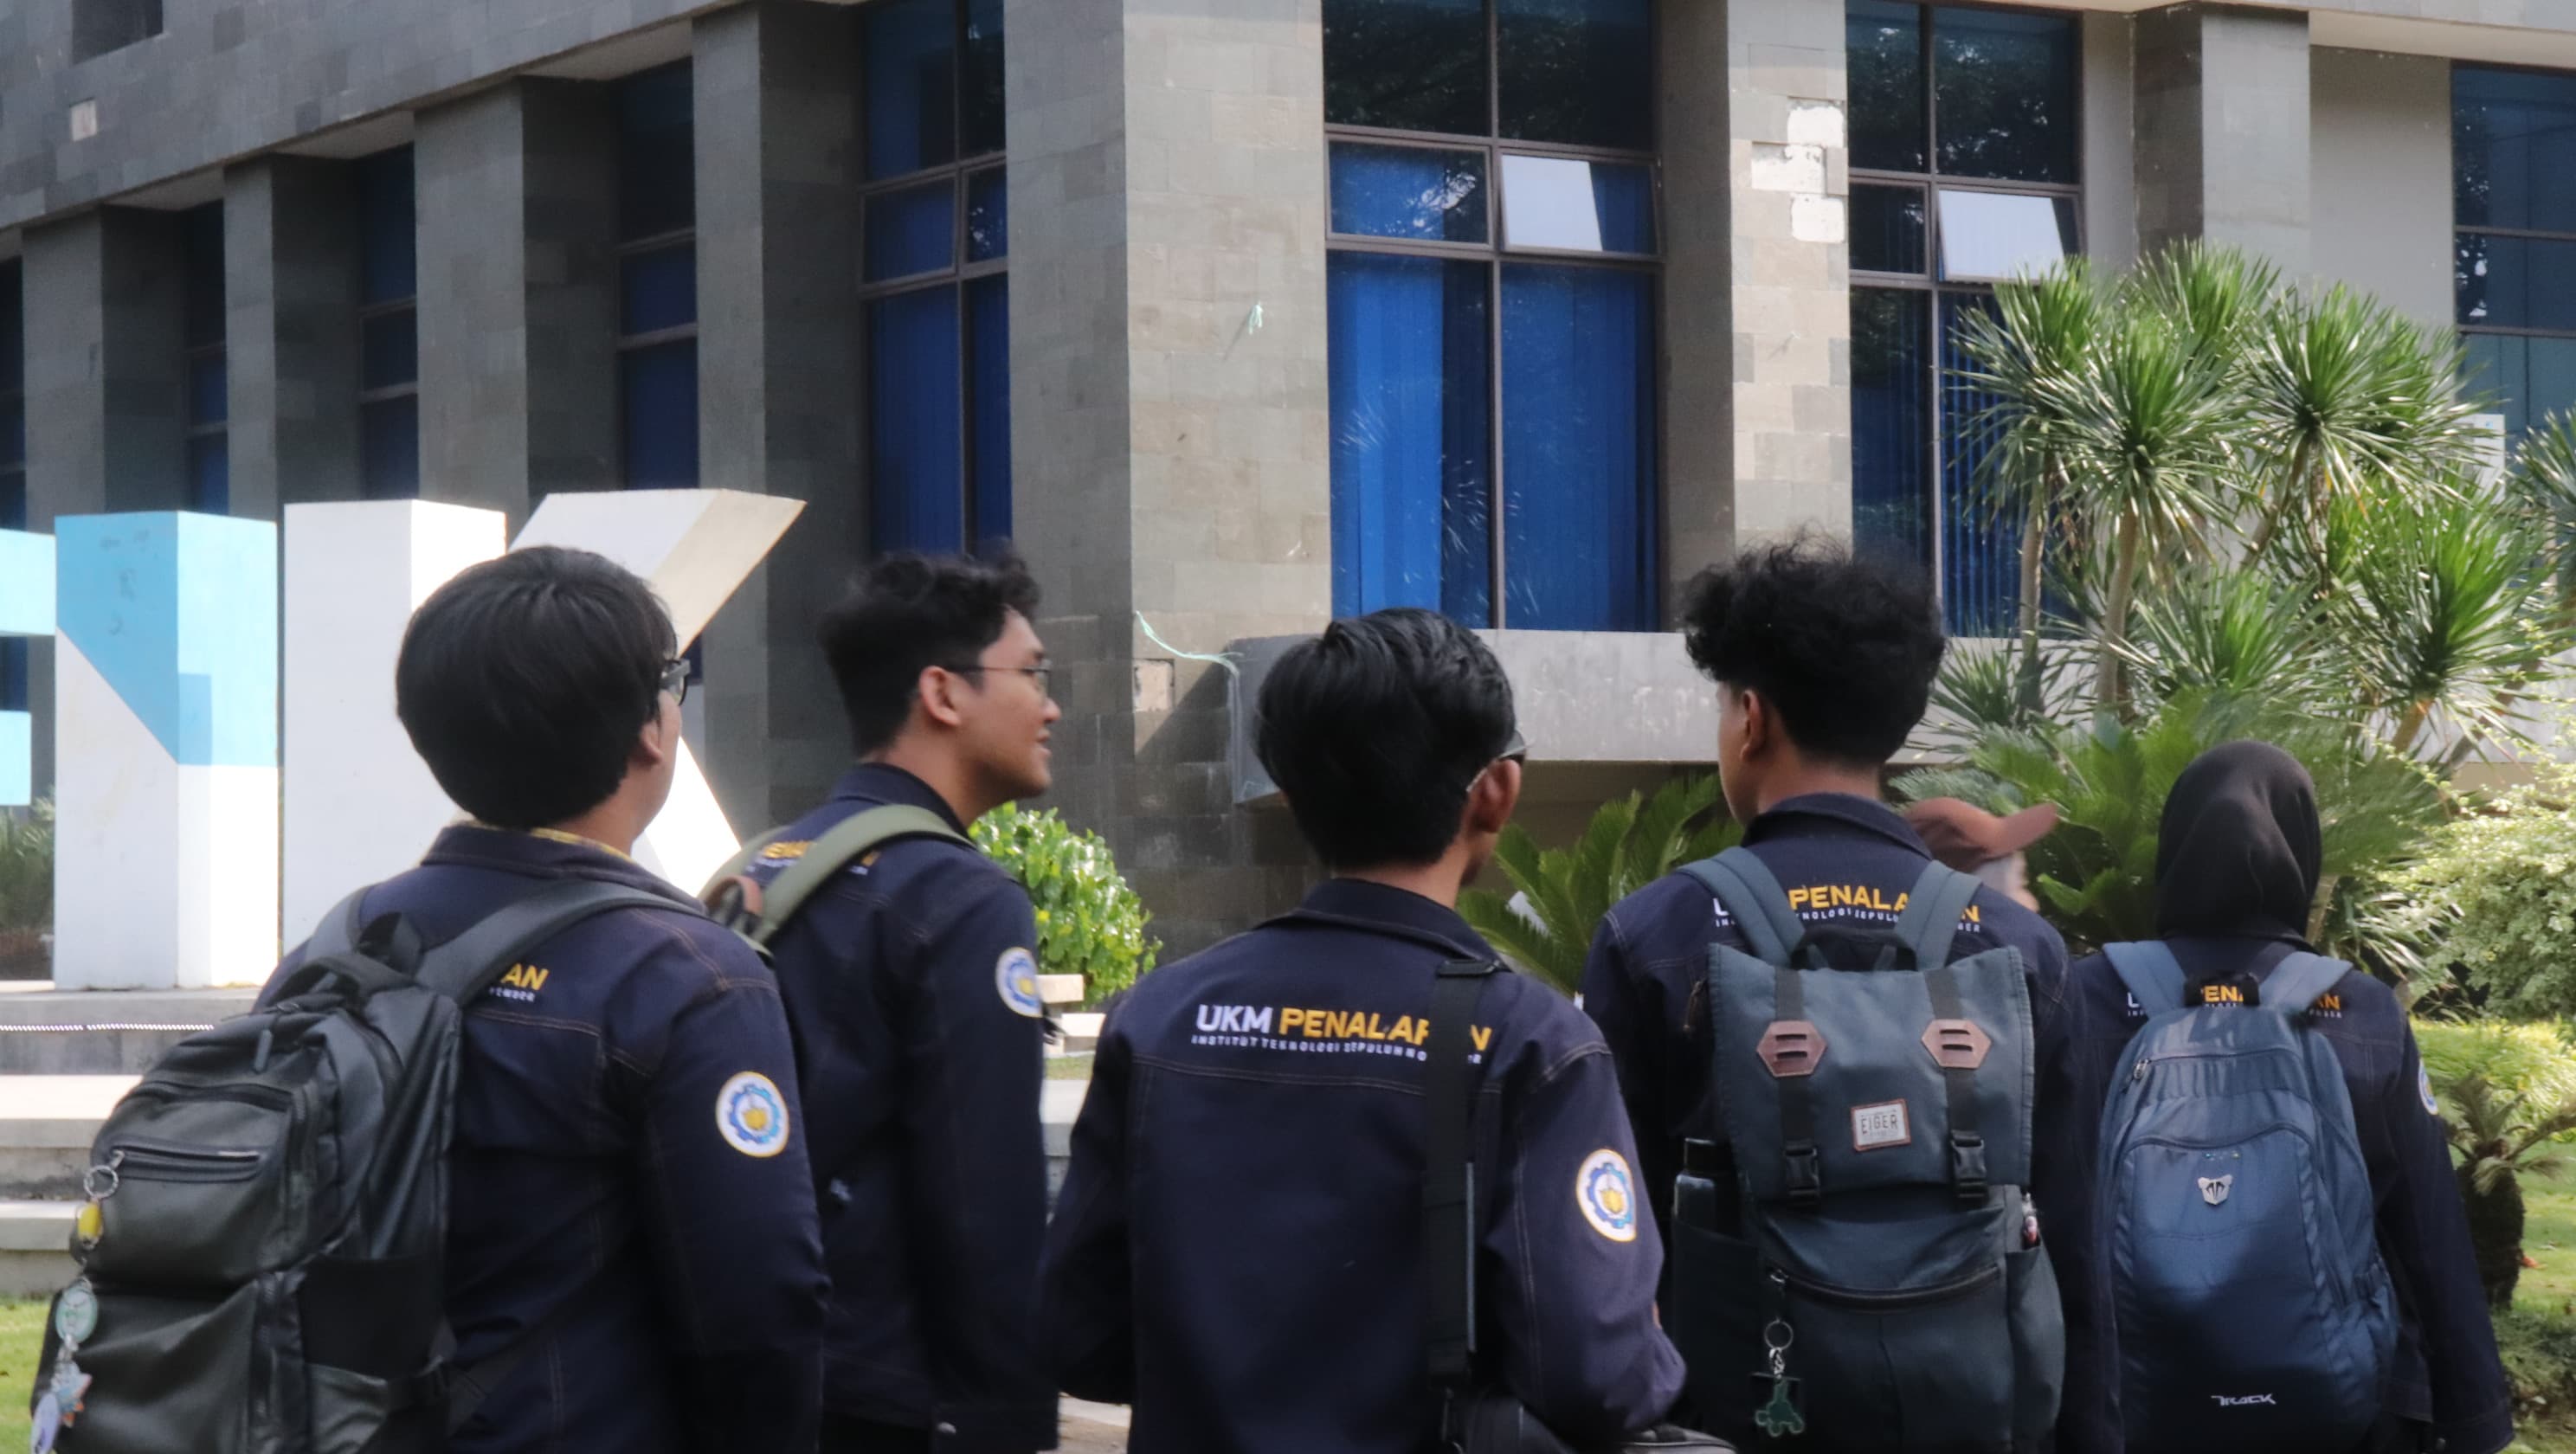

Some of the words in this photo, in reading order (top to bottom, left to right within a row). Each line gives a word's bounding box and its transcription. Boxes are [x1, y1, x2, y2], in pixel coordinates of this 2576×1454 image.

[1787, 885, 1980, 923] PENALAN
[1196, 1003, 1273, 1034] UKM
[1278, 1007, 1493, 1052] PENALARN
[1191, 1034, 1259, 1047] INSTITUT
[1260, 1037, 1341, 1053] TEKNOLOGI
[1343, 1041, 1403, 1057] SEPULUH
[1861, 1113, 1898, 1136] EIGER
